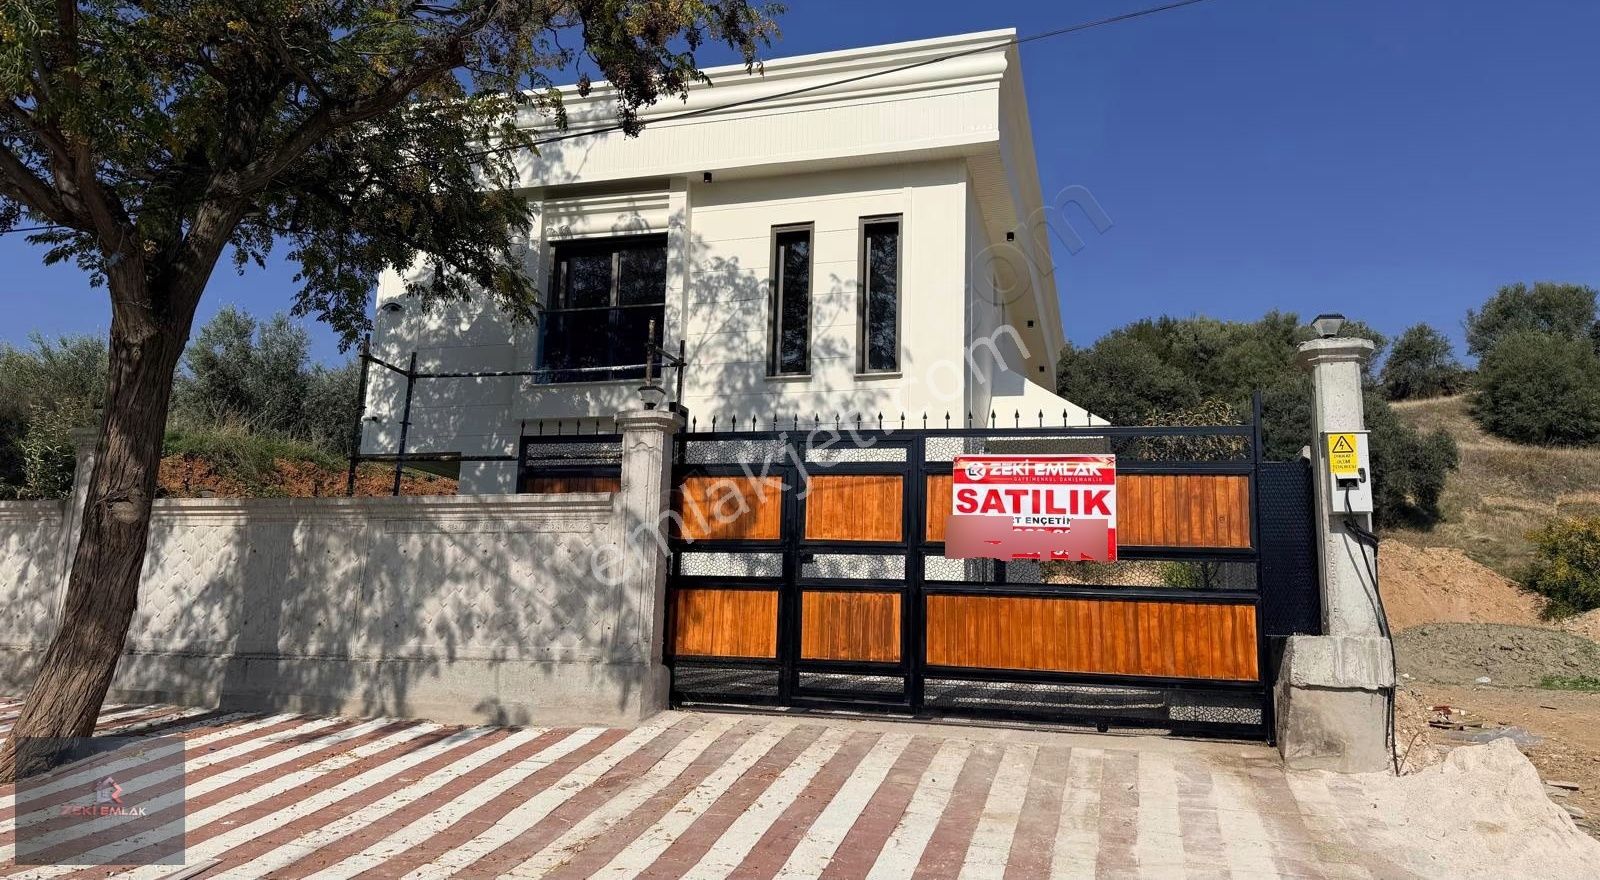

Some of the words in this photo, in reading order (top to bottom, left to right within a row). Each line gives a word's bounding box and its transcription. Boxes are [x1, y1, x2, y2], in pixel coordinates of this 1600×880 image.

[990, 459, 1029, 476] ZEKİ
[1035, 463, 1102, 476] EMLAK
[956, 488, 1112, 516] SATILIK
